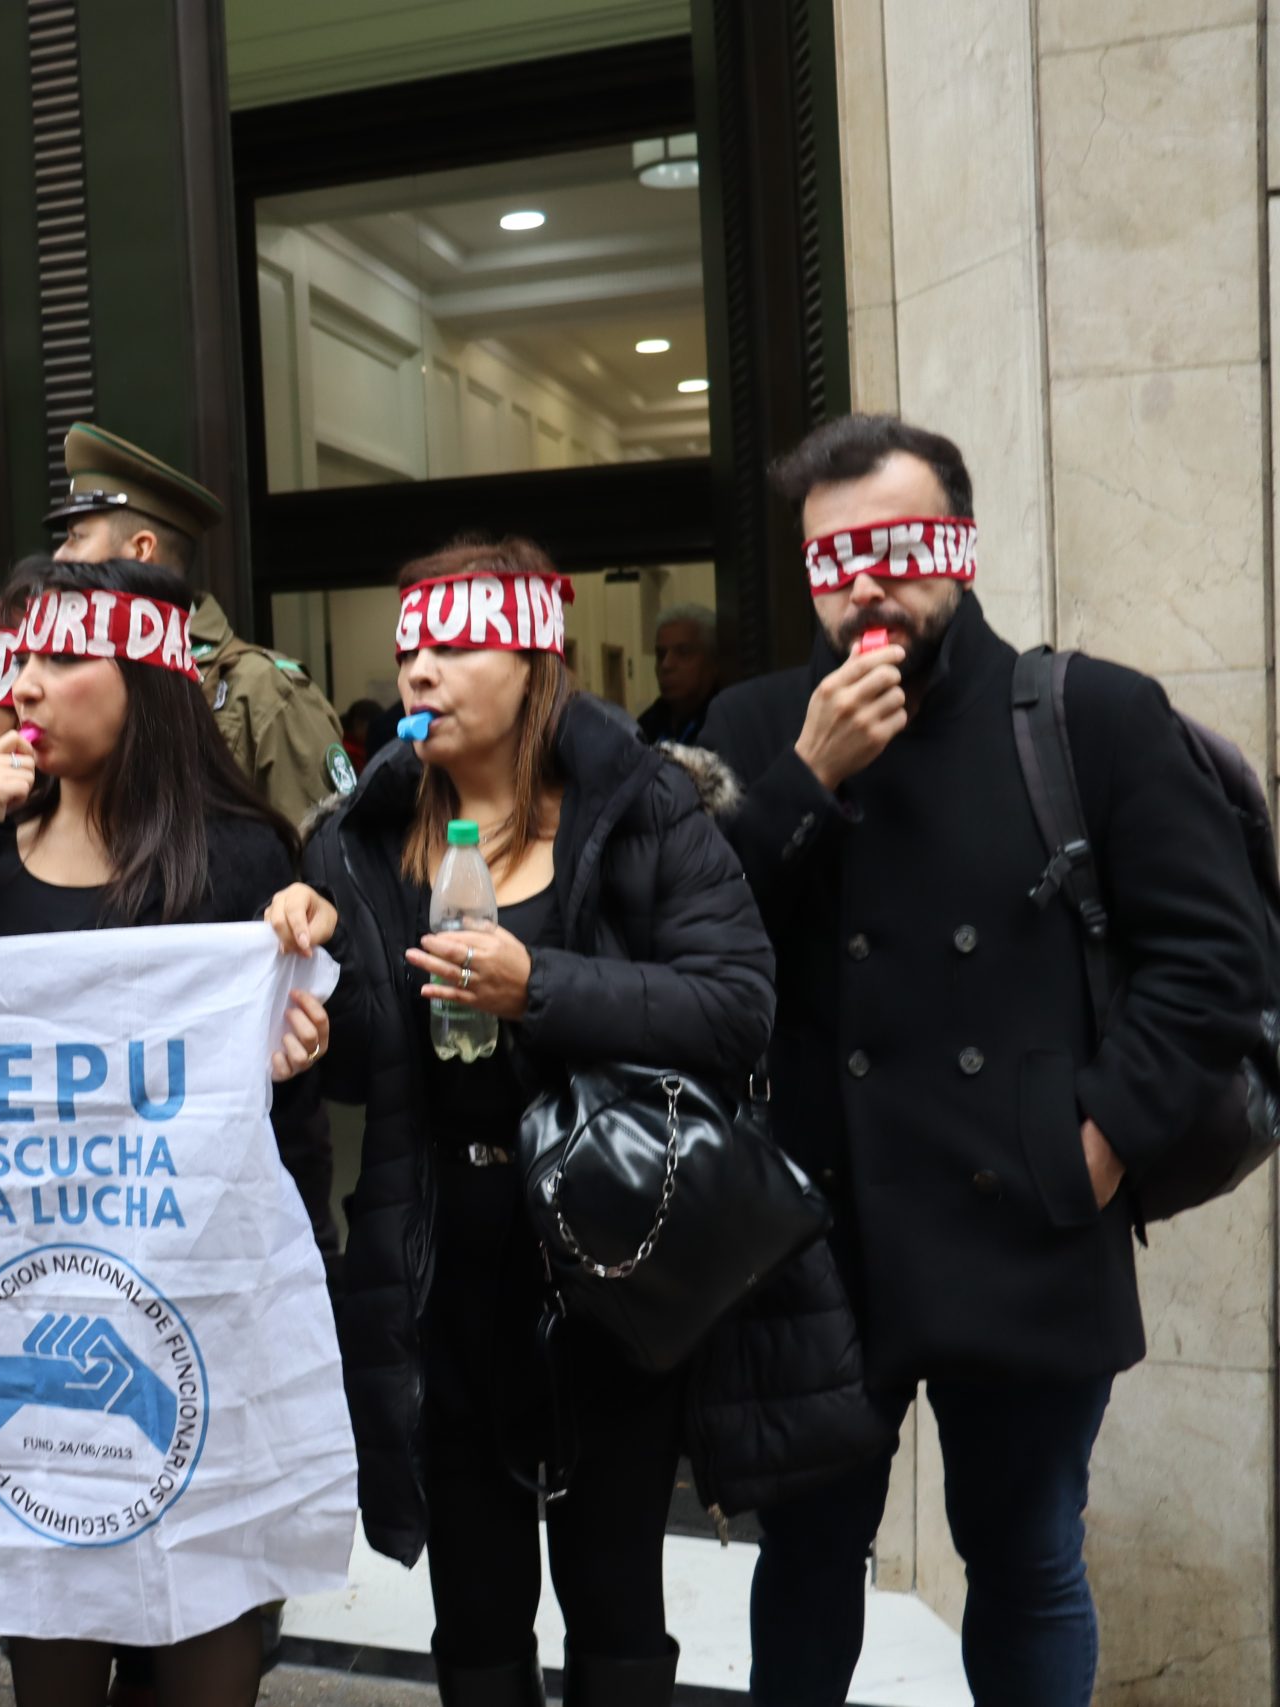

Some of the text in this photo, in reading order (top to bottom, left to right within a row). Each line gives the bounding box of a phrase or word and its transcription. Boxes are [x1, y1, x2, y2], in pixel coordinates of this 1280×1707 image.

[32, 1184, 187, 1228] LUCHA
[52, 1254, 143, 1307] NACIONAL
[145, 1300, 173, 1335] DE
[149, 1329, 198, 1505] FUNCIONARIOS
[59, 1440, 133, 1460] 24/06/2013
[11, 1486, 120, 1537] SEGURIDAD
[122, 1501, 151, 1527] DE
